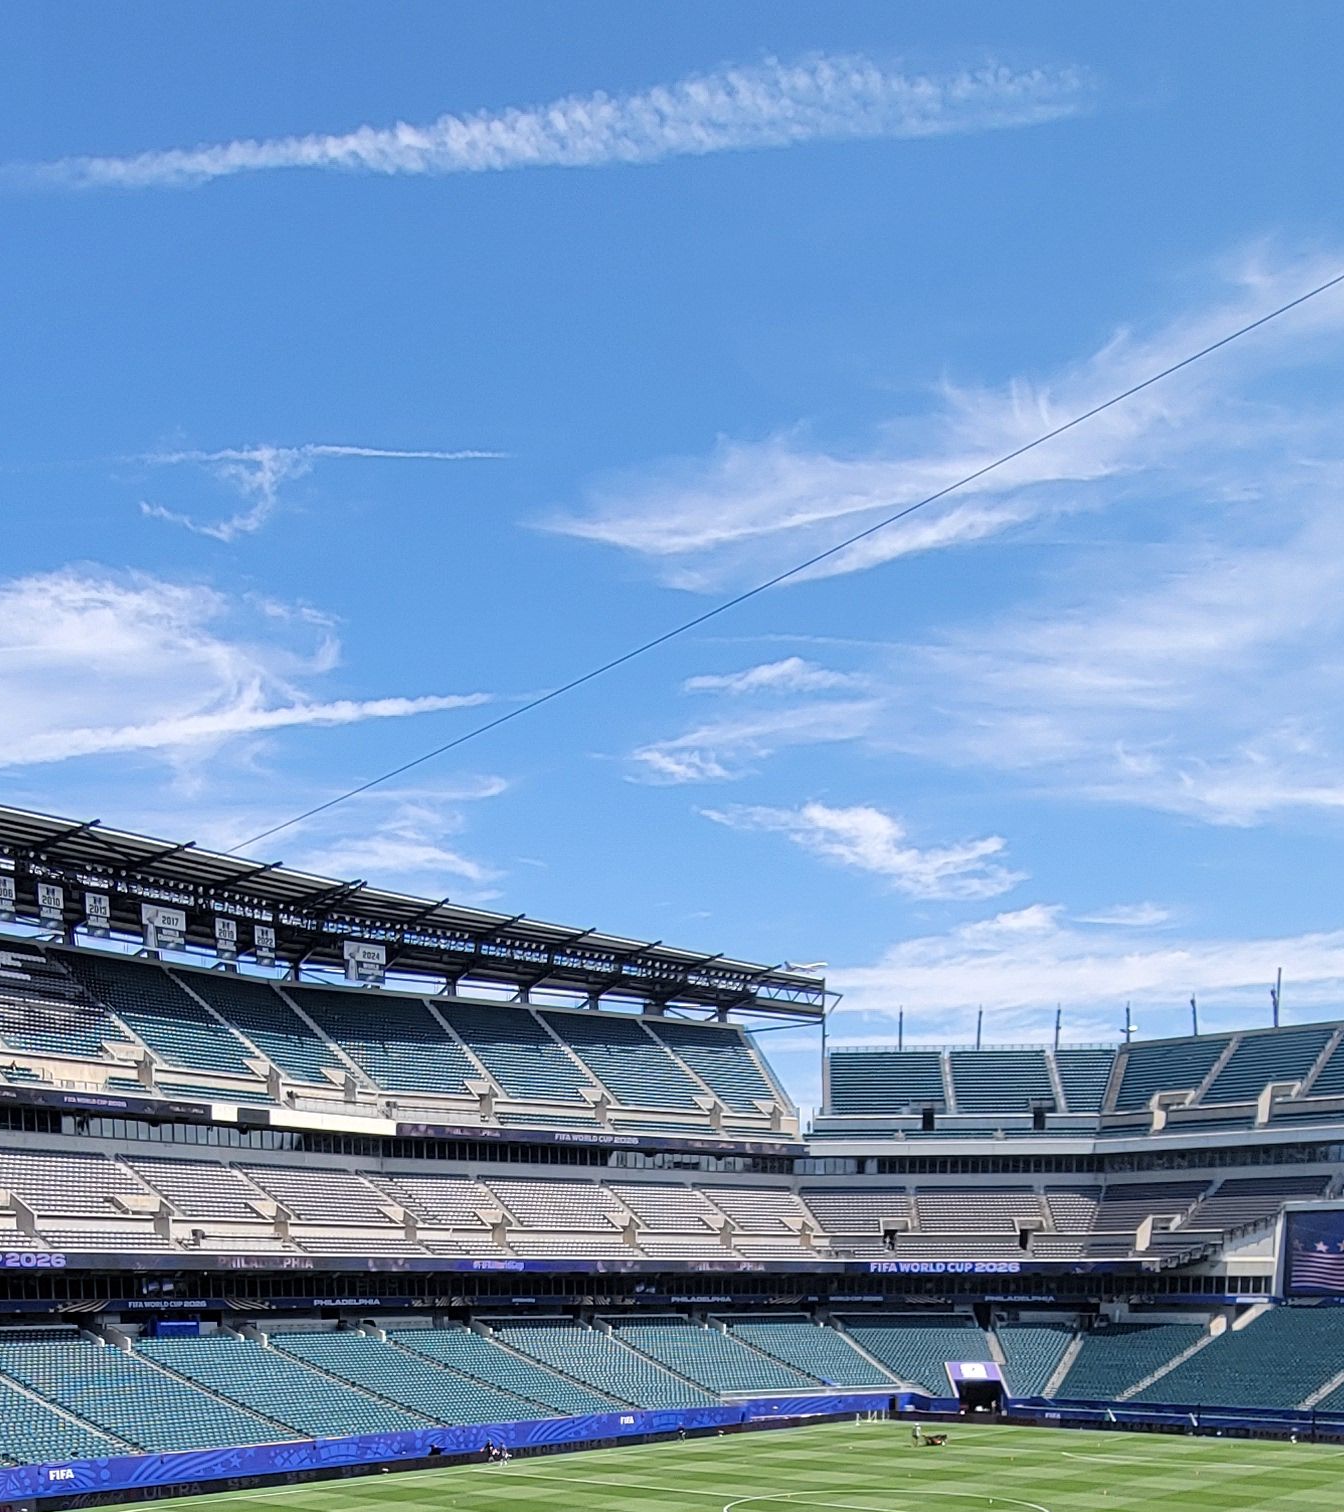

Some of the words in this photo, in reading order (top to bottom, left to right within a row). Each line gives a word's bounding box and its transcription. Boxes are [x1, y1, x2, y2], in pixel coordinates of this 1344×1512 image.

[41, 896, 61, 907] 2010
[161, 916, 179, 927] 2017
[362, 951, 380, 961] 2024
[5, 1252, 67, 1268] 2026
[870, 1262, 897, 1273] FIFA
[898, 1262, 945, 1273] WORLD
[947, 1262, 973, 1273] CUP
[975, 1262, 1021, 1273] 2026
[313, 1298, 380, 1306] PHILADELPHIA
[620, 1416, 635, 1425] FIFA
[49, 1468, 74, 1481] FIFA
[144, 1483, 204, 1499] ULTRA
